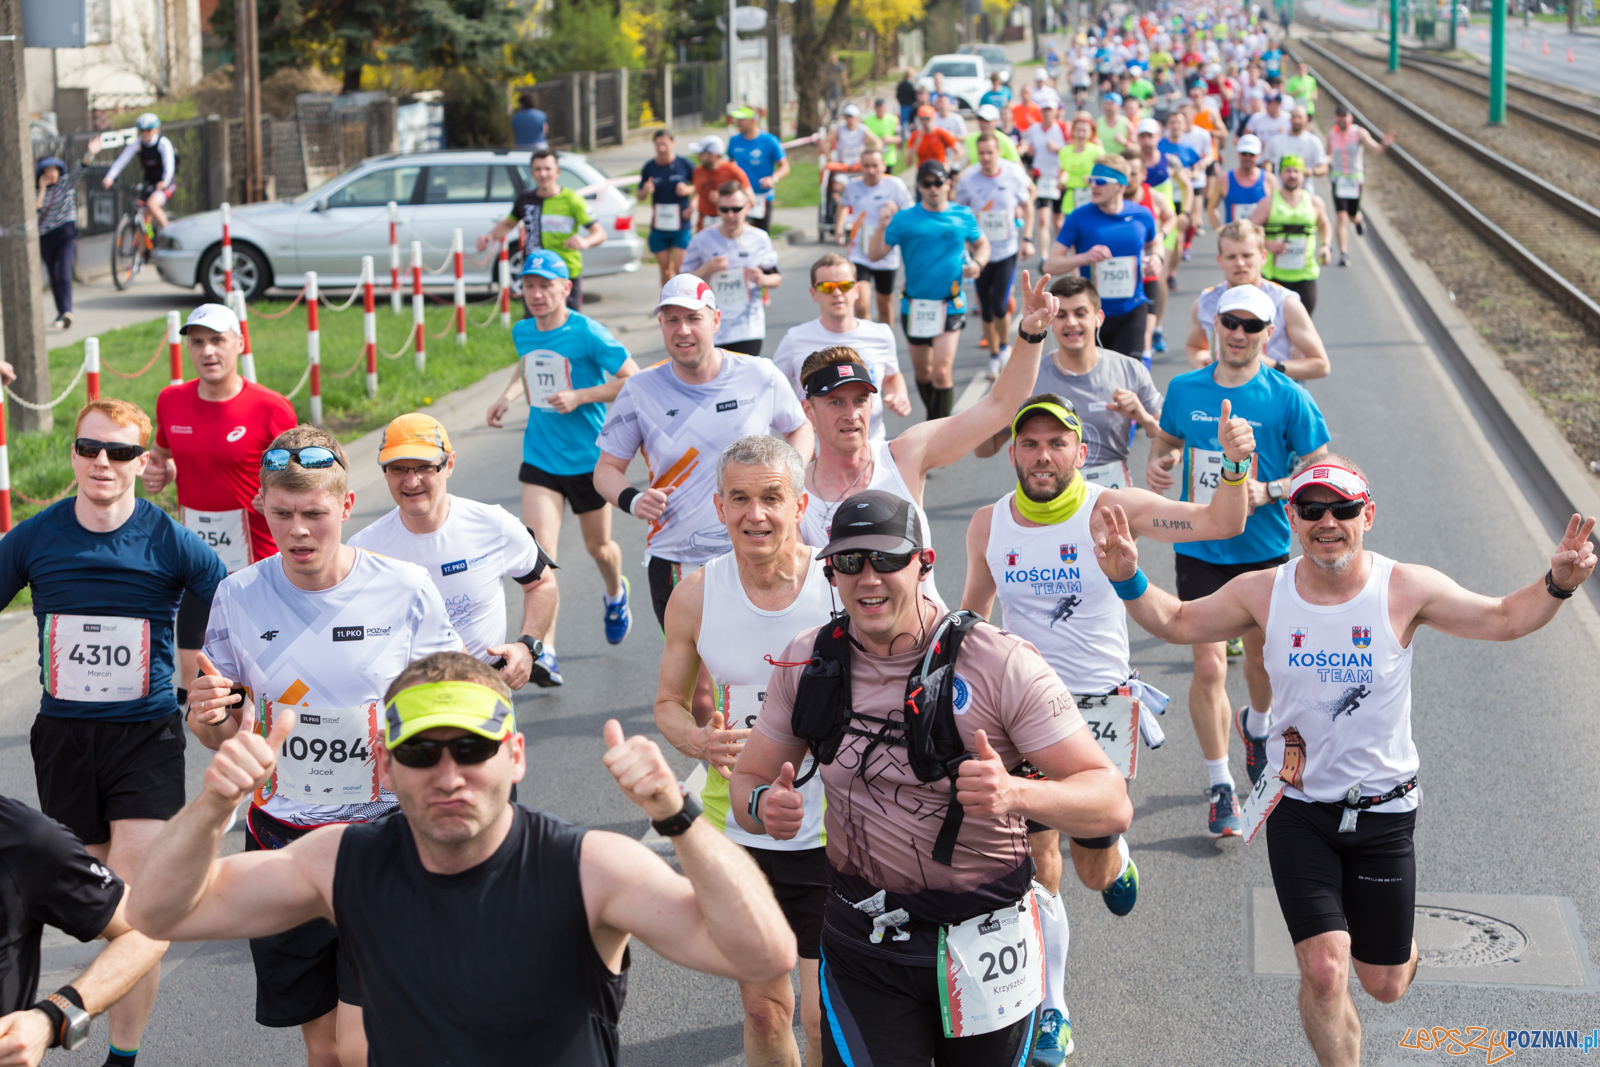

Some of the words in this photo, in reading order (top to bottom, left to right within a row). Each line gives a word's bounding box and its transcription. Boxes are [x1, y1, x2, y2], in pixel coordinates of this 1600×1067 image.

[537, 373, 555, 386] 171
[1005, 566, 1080, 583] KOŚCIAN
[1031, 580, 1082, 595] TEAM
[260, 630, 279, 641] 4F
[69, 644, 131, 666] 4310
[1288, 649, 1372, 667] KOŚCIAN
[1317, 668, 1373, 683] TEAM
[1087, 720, 1118, 742] 34
[282, 736, 369, 763] 10984
[309, 767, 334, 776] Jacek
[993, 976, 1026, 995] Krzysztof
